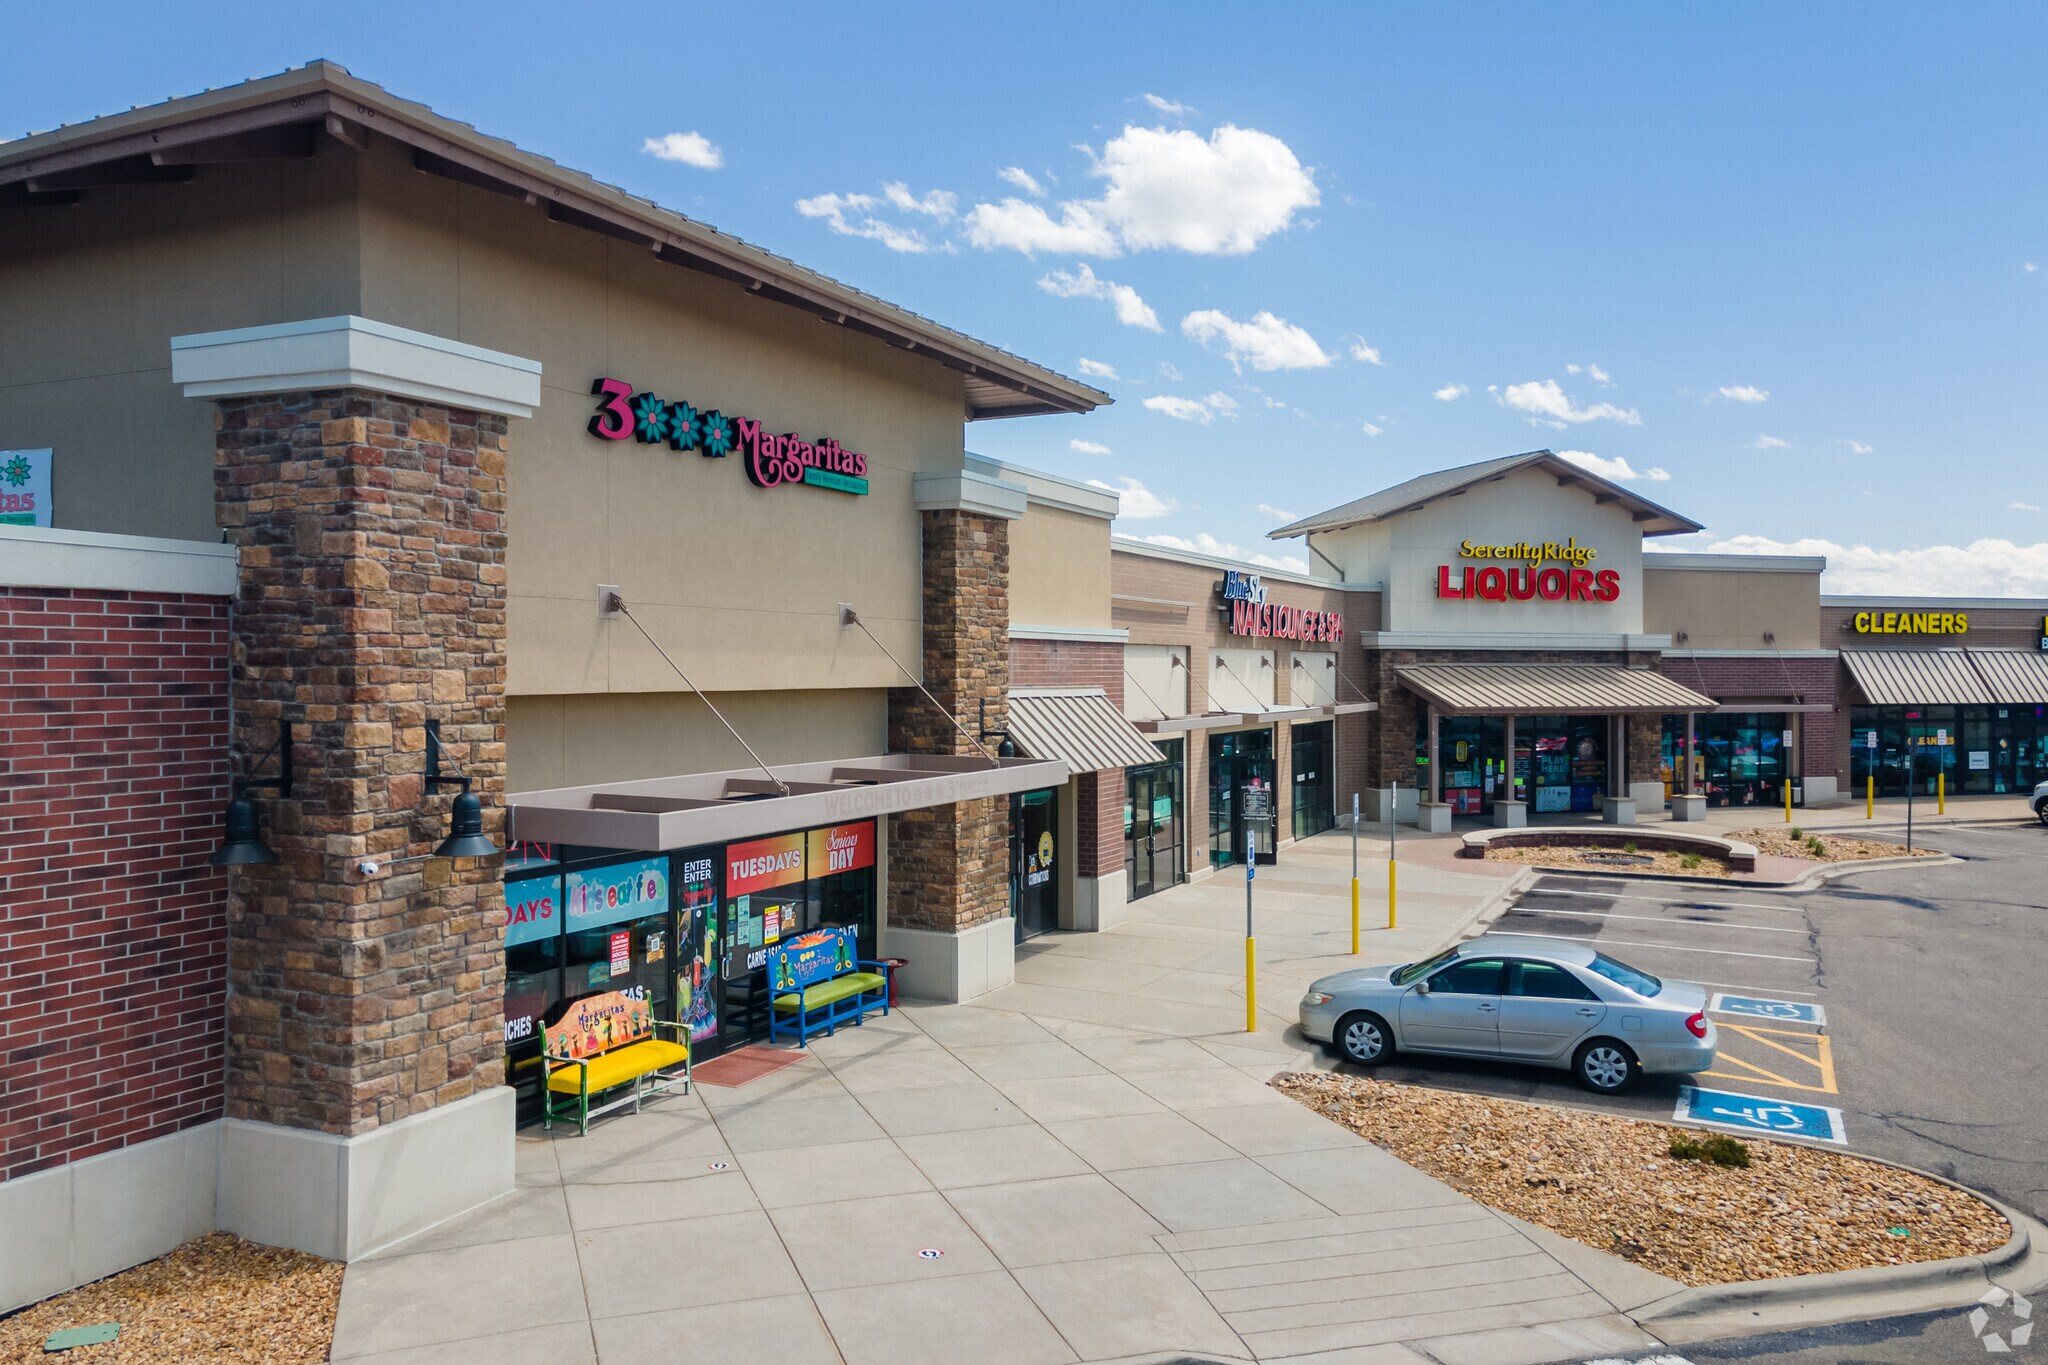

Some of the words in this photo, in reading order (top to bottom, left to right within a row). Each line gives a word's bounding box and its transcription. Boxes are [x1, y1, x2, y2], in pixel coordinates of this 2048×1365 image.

[588, 378, 635, 440] 3
[734, 416, 867, 488] Margaritas
[1438, 566, 1620, 603] LIQUORS
[1233, 600, 1271, 637] NAILS
[1273, 604, 1317, 642] LOUNGE
[1326, 612, 1344, 642] SPA
[1854, 612, 1968, 634] CLEANERS
[1541, 755, 1565, 765] PLAY
[825, 791, 893, 818] WELCOME
[895, 786, 912, 806] TO
[826, 828, 858, 851] Seniors
[684, 859, 711, 873] ENTER
[731, 849, 801, 880] TUESDAYS
[829, 847, 855, 872] DAY
[684, 869, 711, 883] ENTER
[570, 880, 603, 916] Kids
[607, 876, 633, 908] eat
[505, 897, 552, 926] DAYS
[747, 949, 767, 969] CARNE
[578, 1004, 625, 1032] Margaritas
